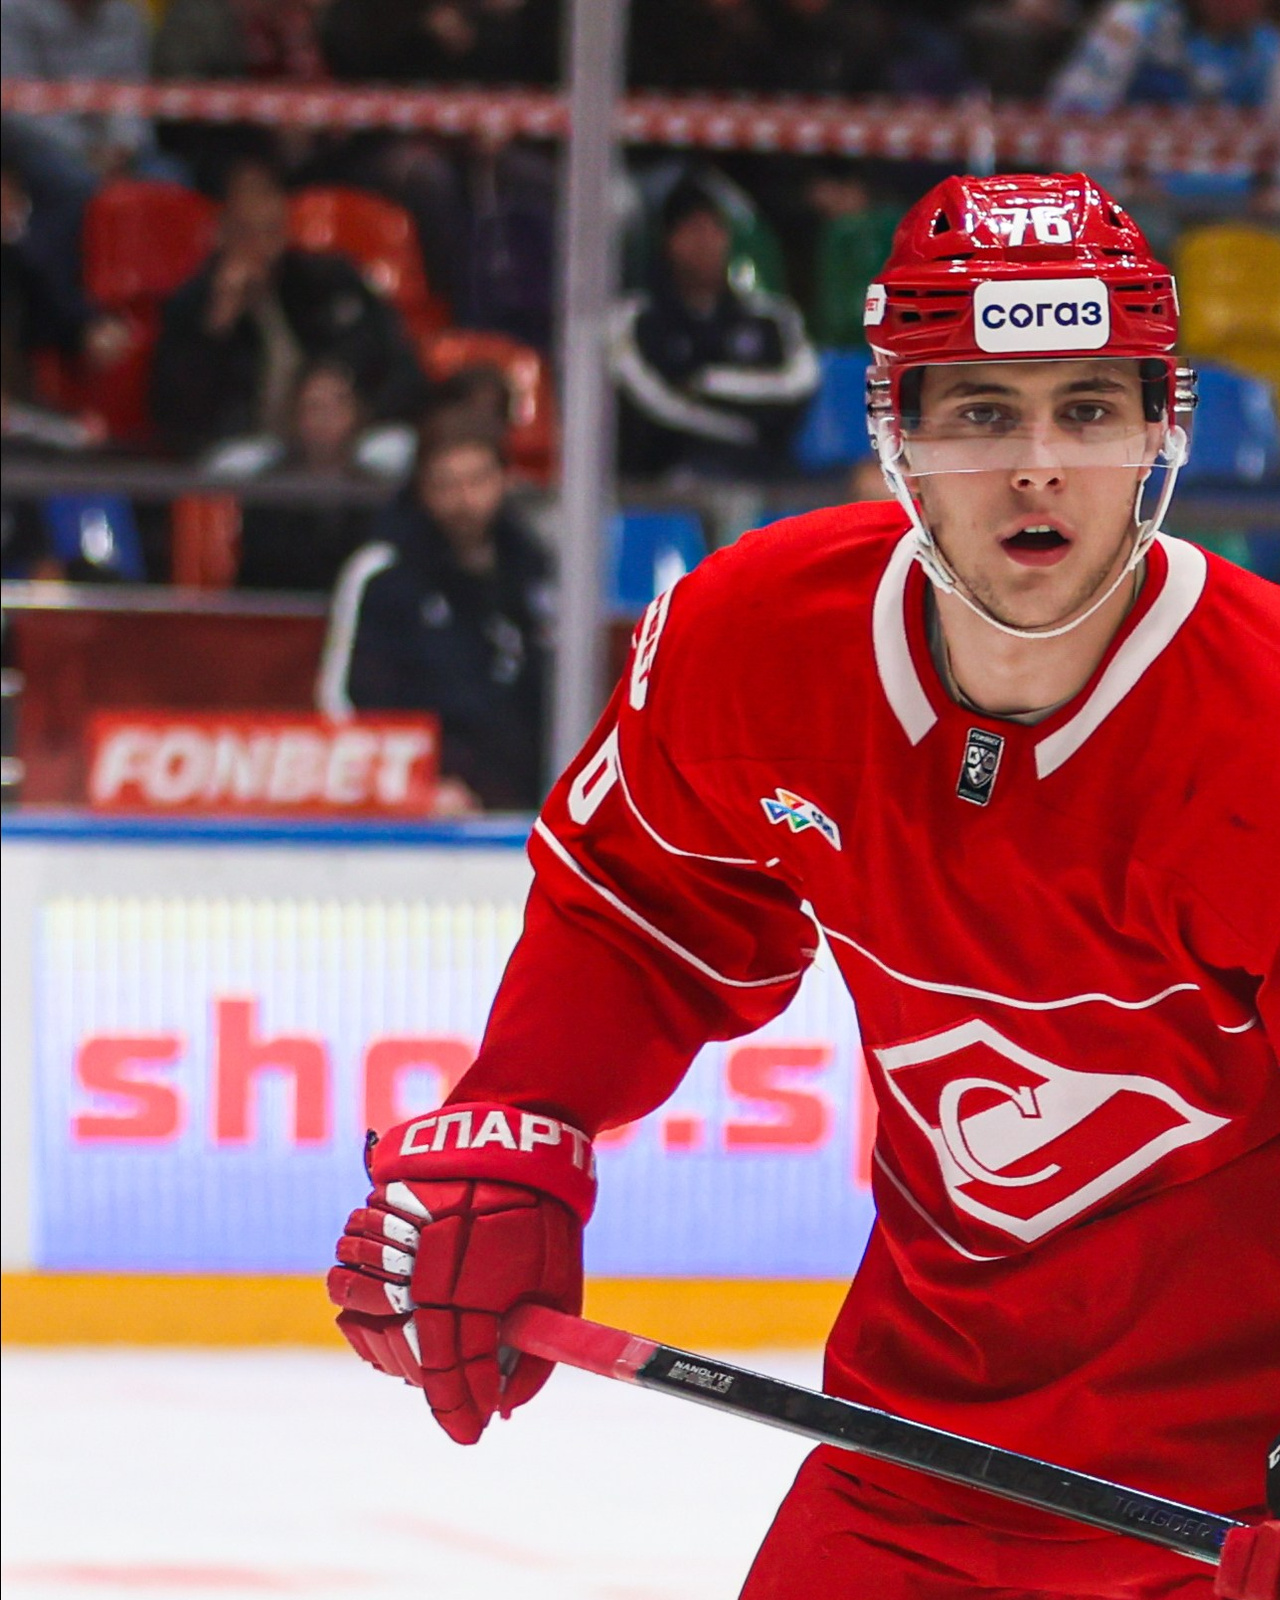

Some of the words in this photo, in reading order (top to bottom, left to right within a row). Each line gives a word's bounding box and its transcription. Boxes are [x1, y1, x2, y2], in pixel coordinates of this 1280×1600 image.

[991, 205, 1073, 246] 76
[981, 301, 1102, 330] согаз
[95, 727, 436, 805] FONBET
[71, 996, 878, 1188] sho.s
[399, 1110, 596, 1181] СПАРТ
[674, 1360, 735, 1384] NANOLITE
